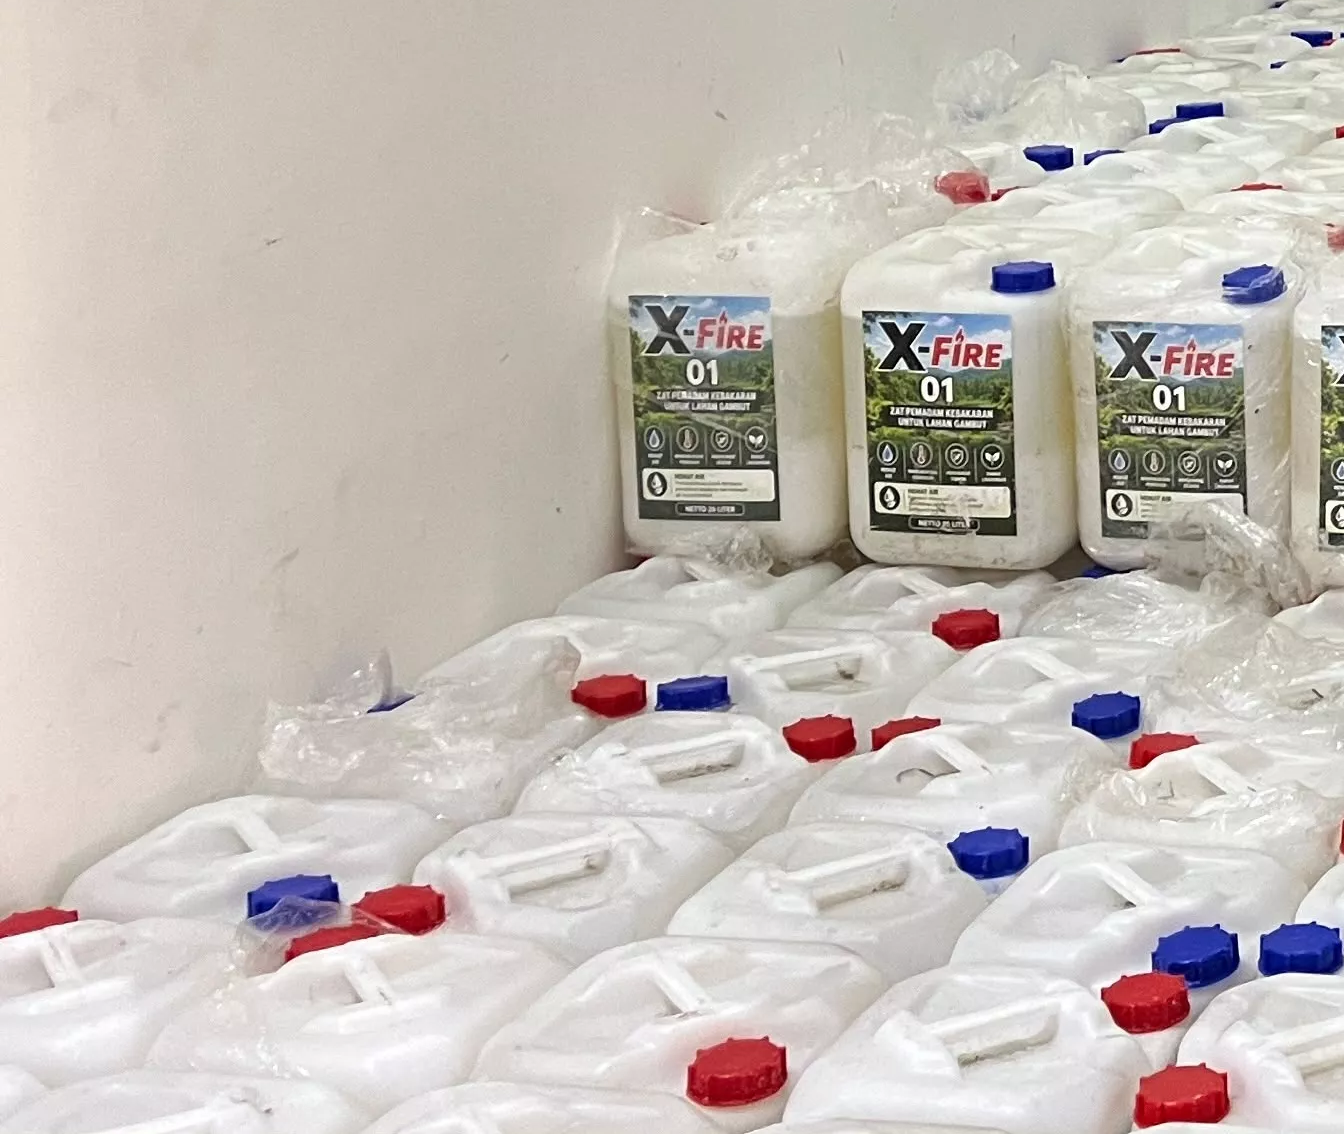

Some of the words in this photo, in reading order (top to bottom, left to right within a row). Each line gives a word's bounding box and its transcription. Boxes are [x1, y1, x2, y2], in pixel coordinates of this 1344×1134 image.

[642, 304, 765, 356] X-FIRE
[874, 320, 1003, 373] X-FIRE
[1108, 330, 1235, 381] X-FIRE
[686, 358, 719, 386] 01
[920, 376, 954, 403] 01
[1152, 384, 1186, 411] 01
[890, 407, 905, 416] ZAT
